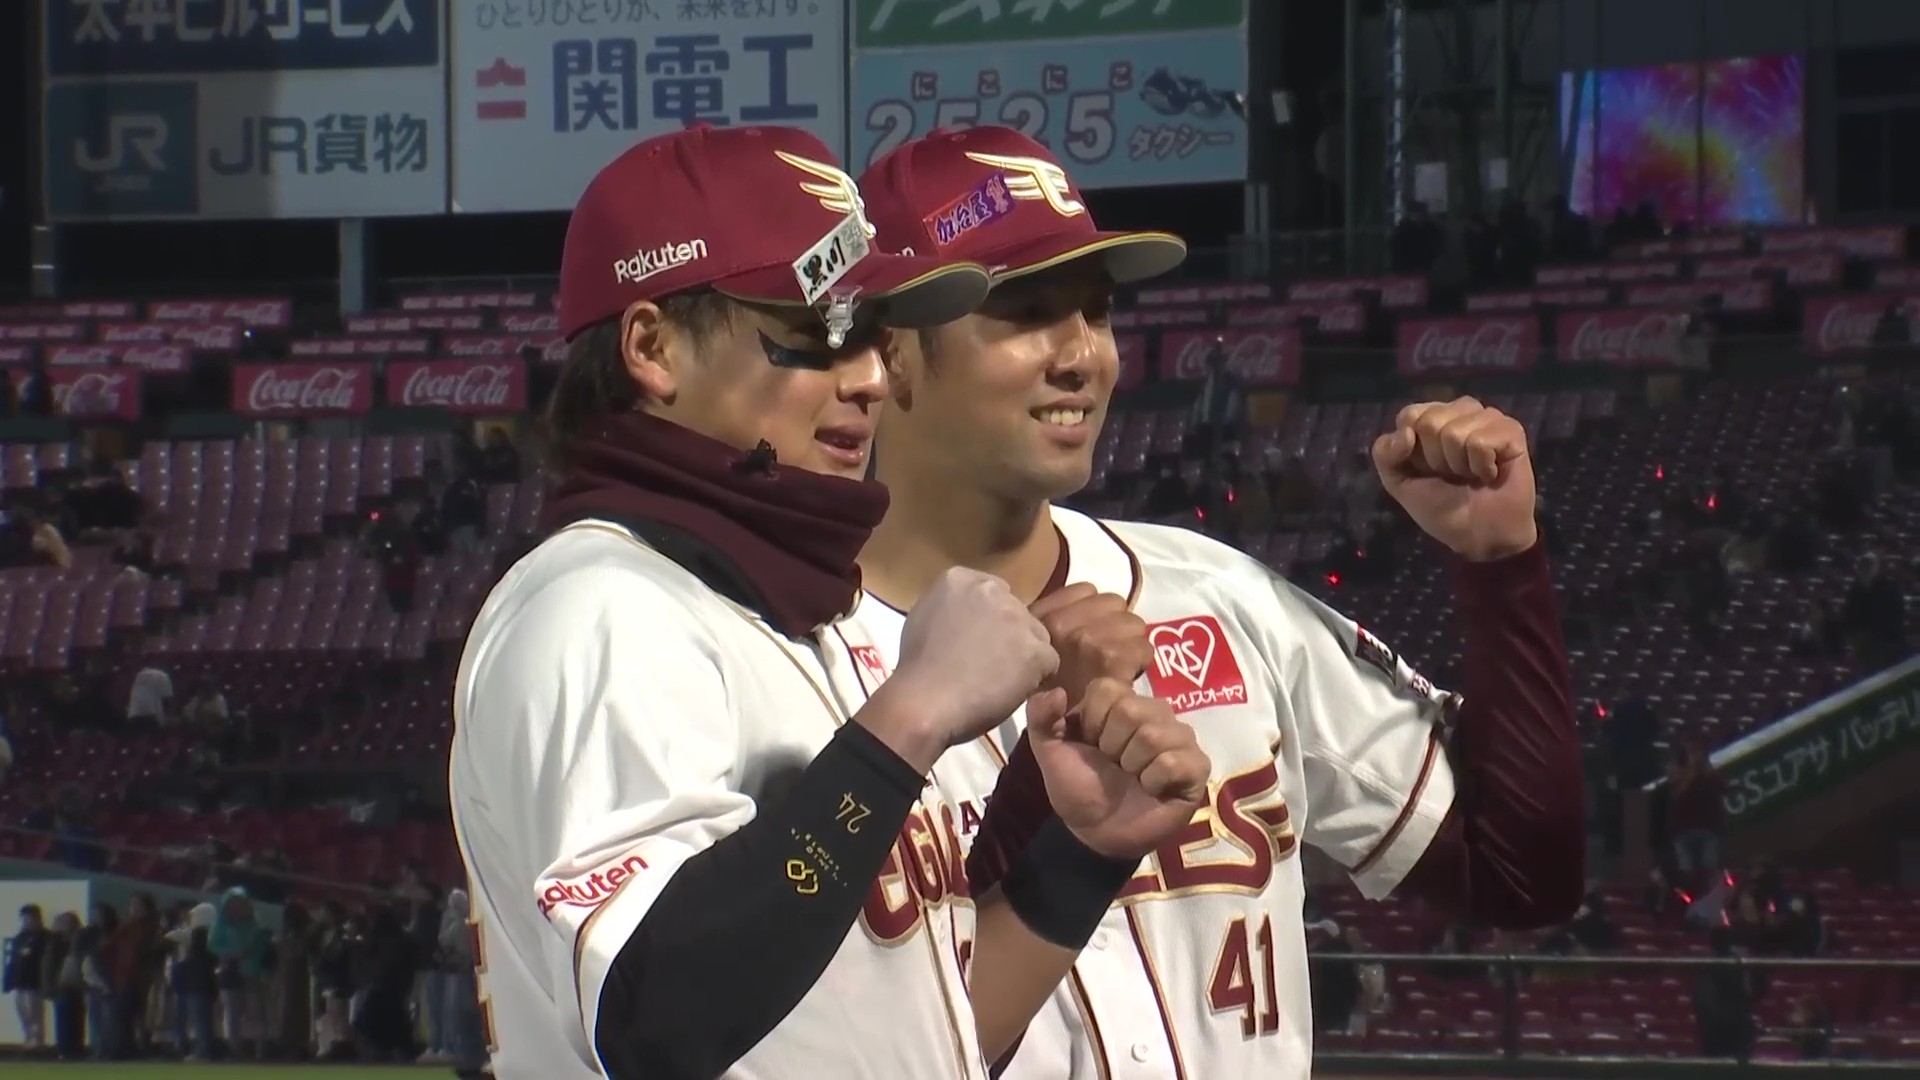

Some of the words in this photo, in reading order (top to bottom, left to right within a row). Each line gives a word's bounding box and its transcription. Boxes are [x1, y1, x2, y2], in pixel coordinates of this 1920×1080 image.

[553, 33, 819, 132] 関電工
[74, 114, 169, 172] JR
[208, 112, 429, 176] JR貨物
[1129, 124, 1234, 161] タクシー
[614, 238, 709, 284] Rakuten
[834, 791, 872, 834] 24
[1206, 908, 1281, 1040] 41
